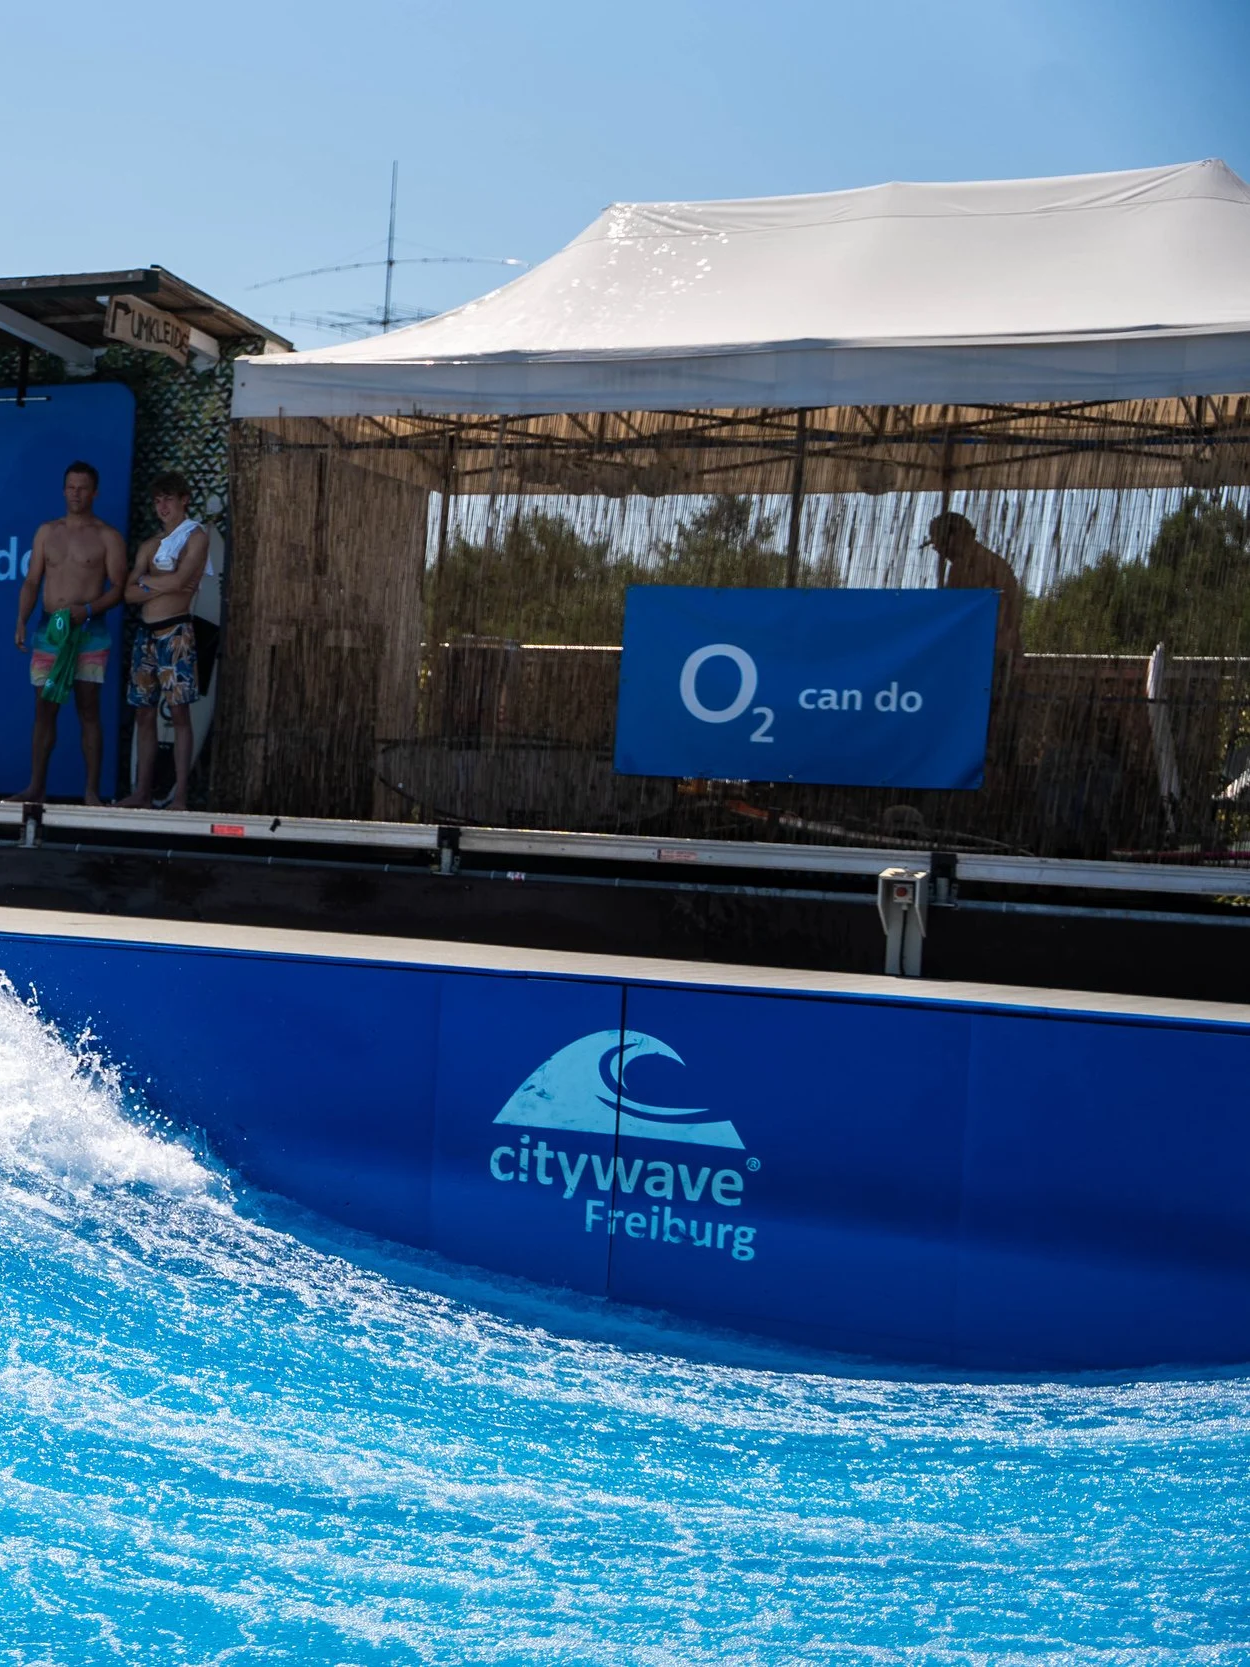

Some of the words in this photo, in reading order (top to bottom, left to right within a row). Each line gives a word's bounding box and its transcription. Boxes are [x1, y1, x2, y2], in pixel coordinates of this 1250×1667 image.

[799, 689, 862, 710] can
[875, 682, 922, 712] do
[585, 1199, 758, 1261] Freiburg
